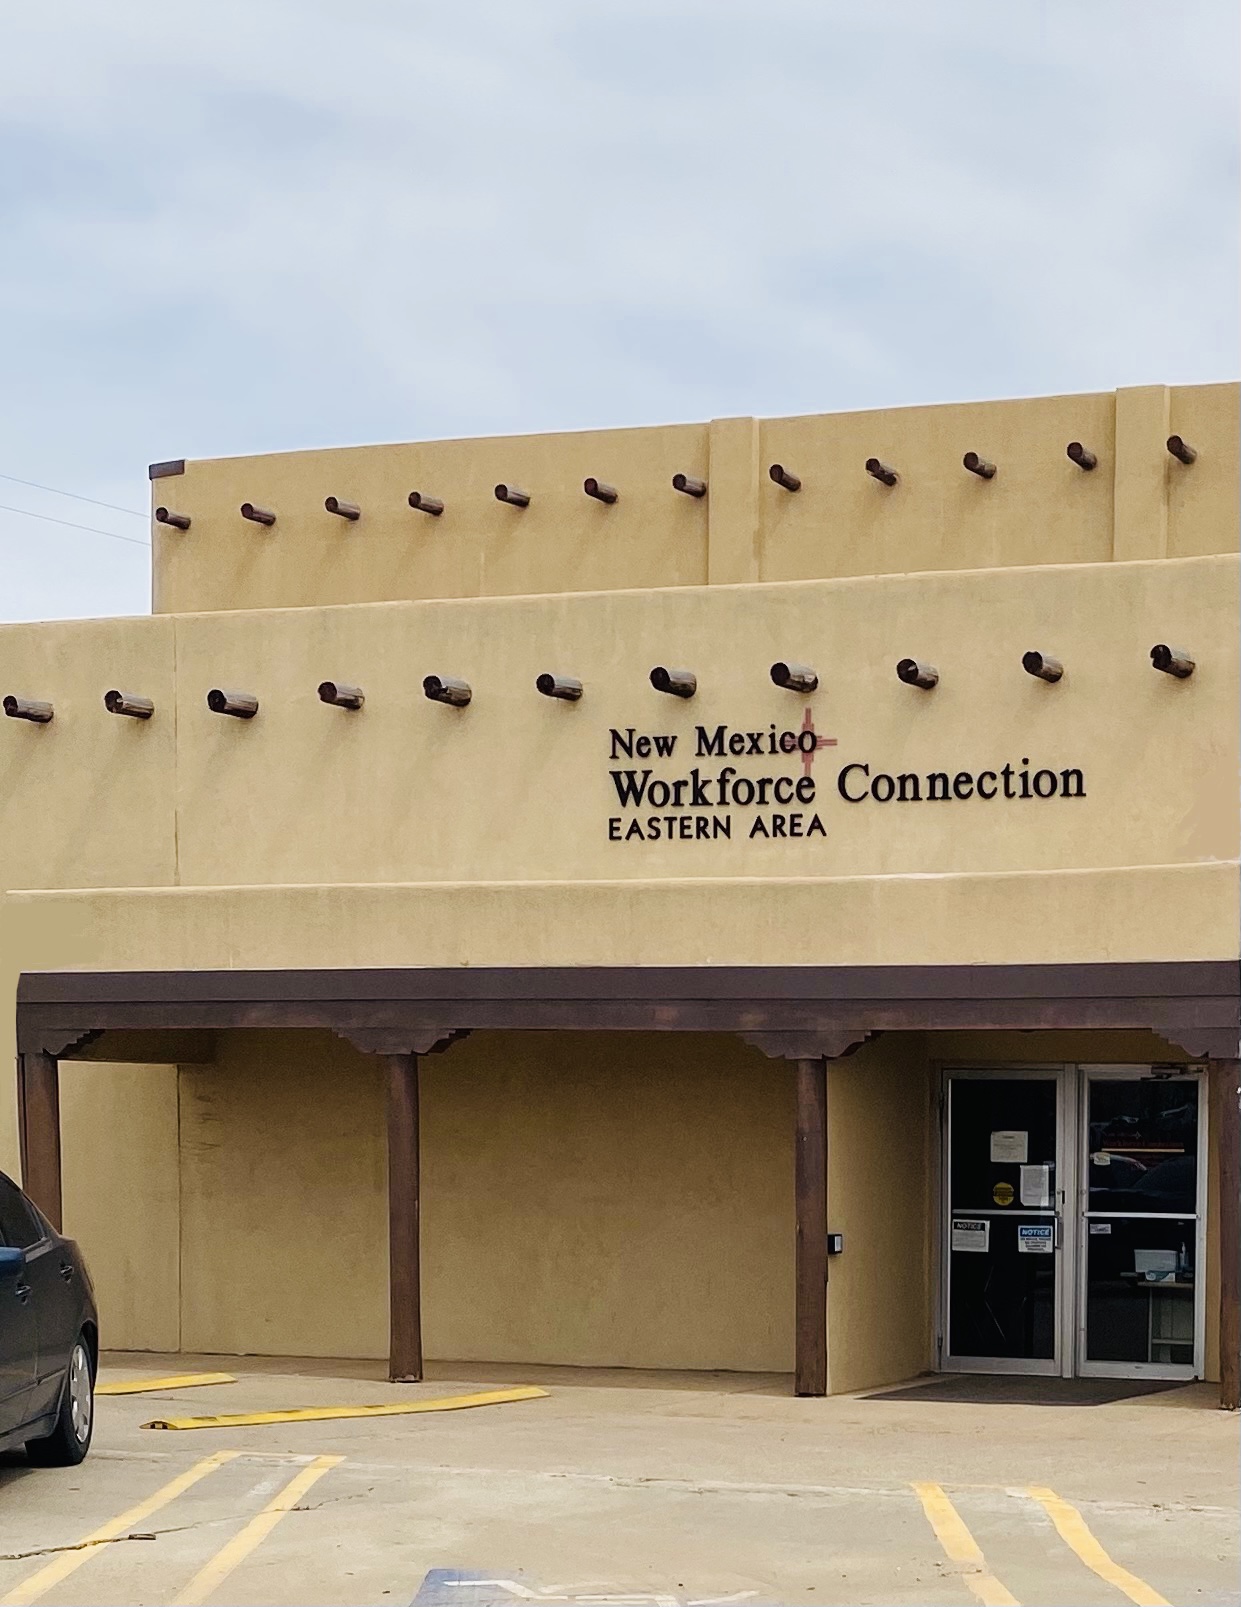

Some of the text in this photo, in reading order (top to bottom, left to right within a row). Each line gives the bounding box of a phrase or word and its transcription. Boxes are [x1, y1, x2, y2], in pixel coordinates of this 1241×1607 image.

[608, 723, 819, 760] New Mexico
[608, 757, 1087, 809] Workforce Connection
[608, 813, 828, 842] EASTERN AREA
[956, 1222, 982, 1230] NOTICE
[1021, 1228, 1050, 1236] NOTICE
